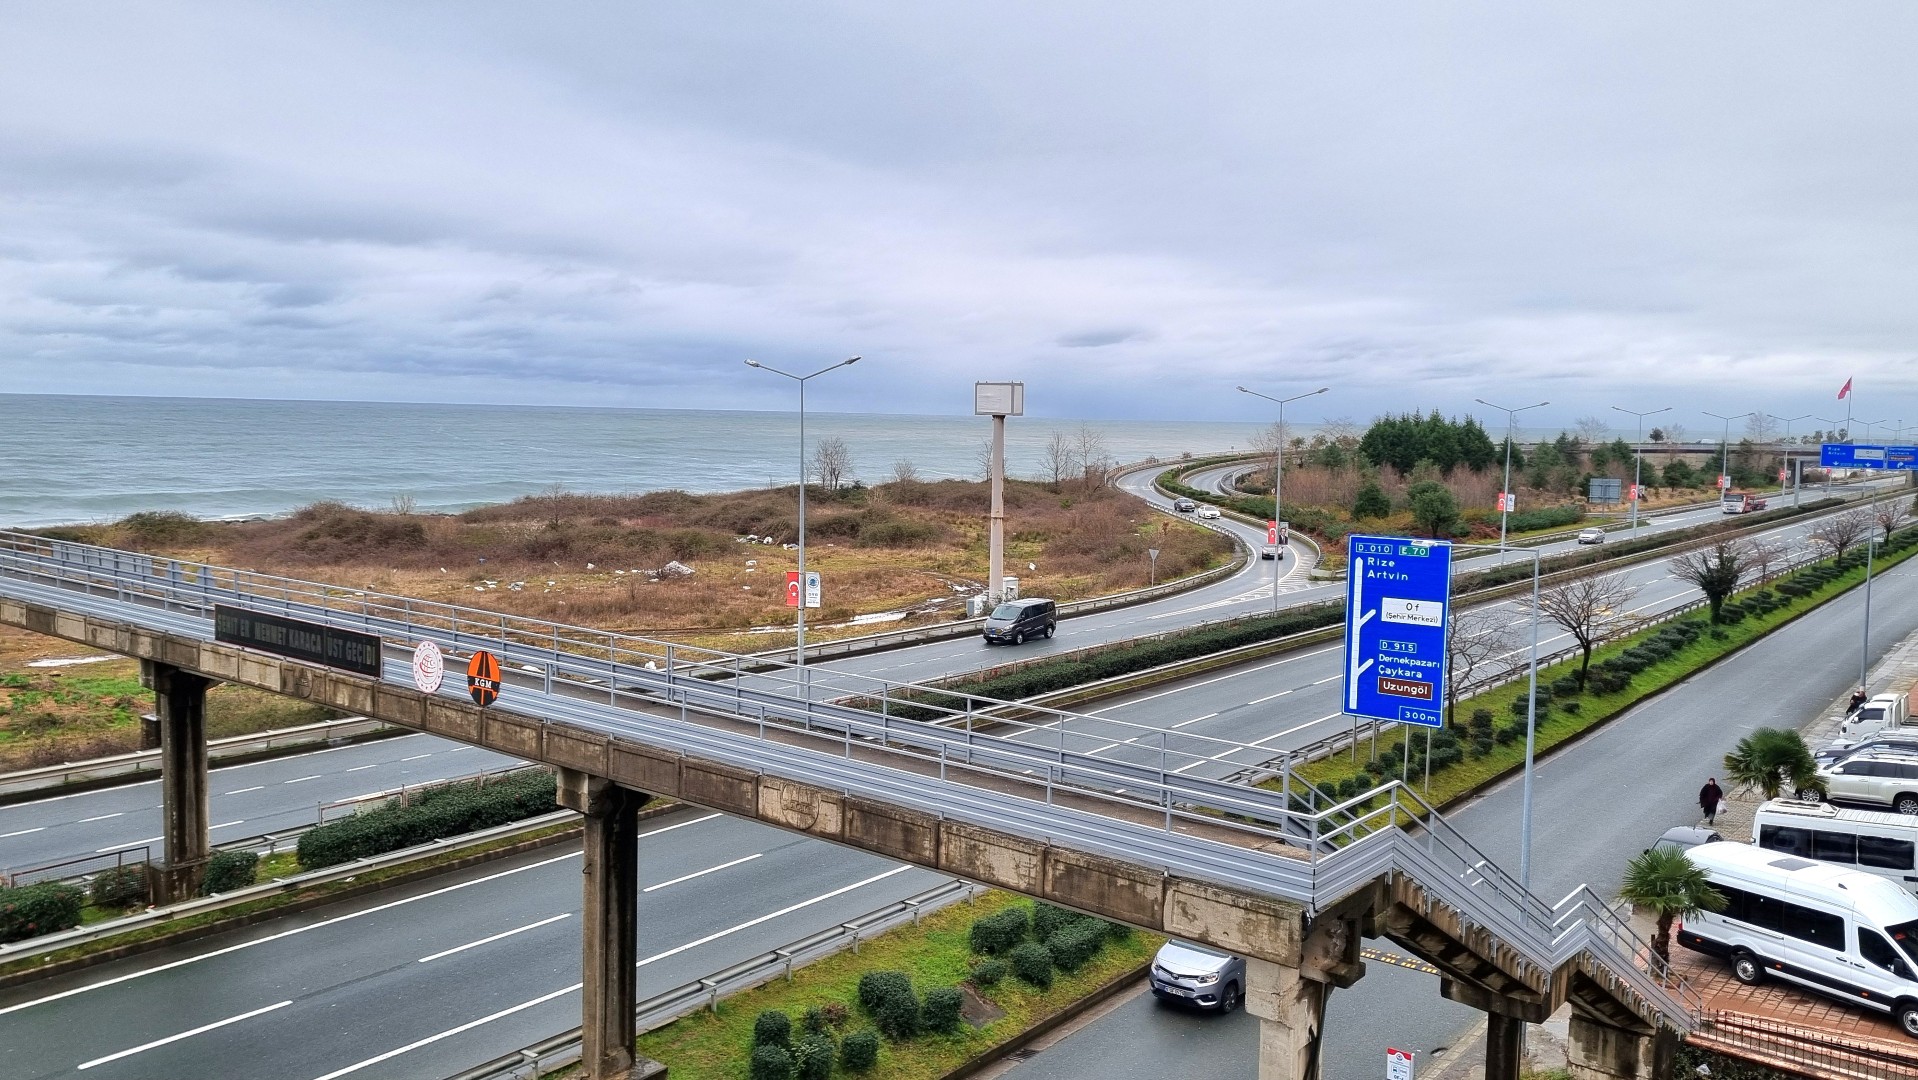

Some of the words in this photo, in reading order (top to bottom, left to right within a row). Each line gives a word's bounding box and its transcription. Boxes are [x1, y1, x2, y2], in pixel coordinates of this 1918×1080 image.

[1367, 556, 1395, 567] Rize
[1367, 569, 1409, 581] Artvin
[1405, 602, 1420, 612] Of
[1385, 611, 1406, 620] (Şehir
[1407, 614, 1439, 624] Merkezi)
[288, 628, 322, 654] KARACA
[327, 631, 343, 659] ÜST
[345, 640, 376, 669] GEÇİDİ
[1378, 653, 1440, 668] Dernekpazarı
[1378, 664, 1423, 678] Çaykara
[474, 677, 492, 689] KGM
[1383, 680, 1428, 695] Uzungöl
